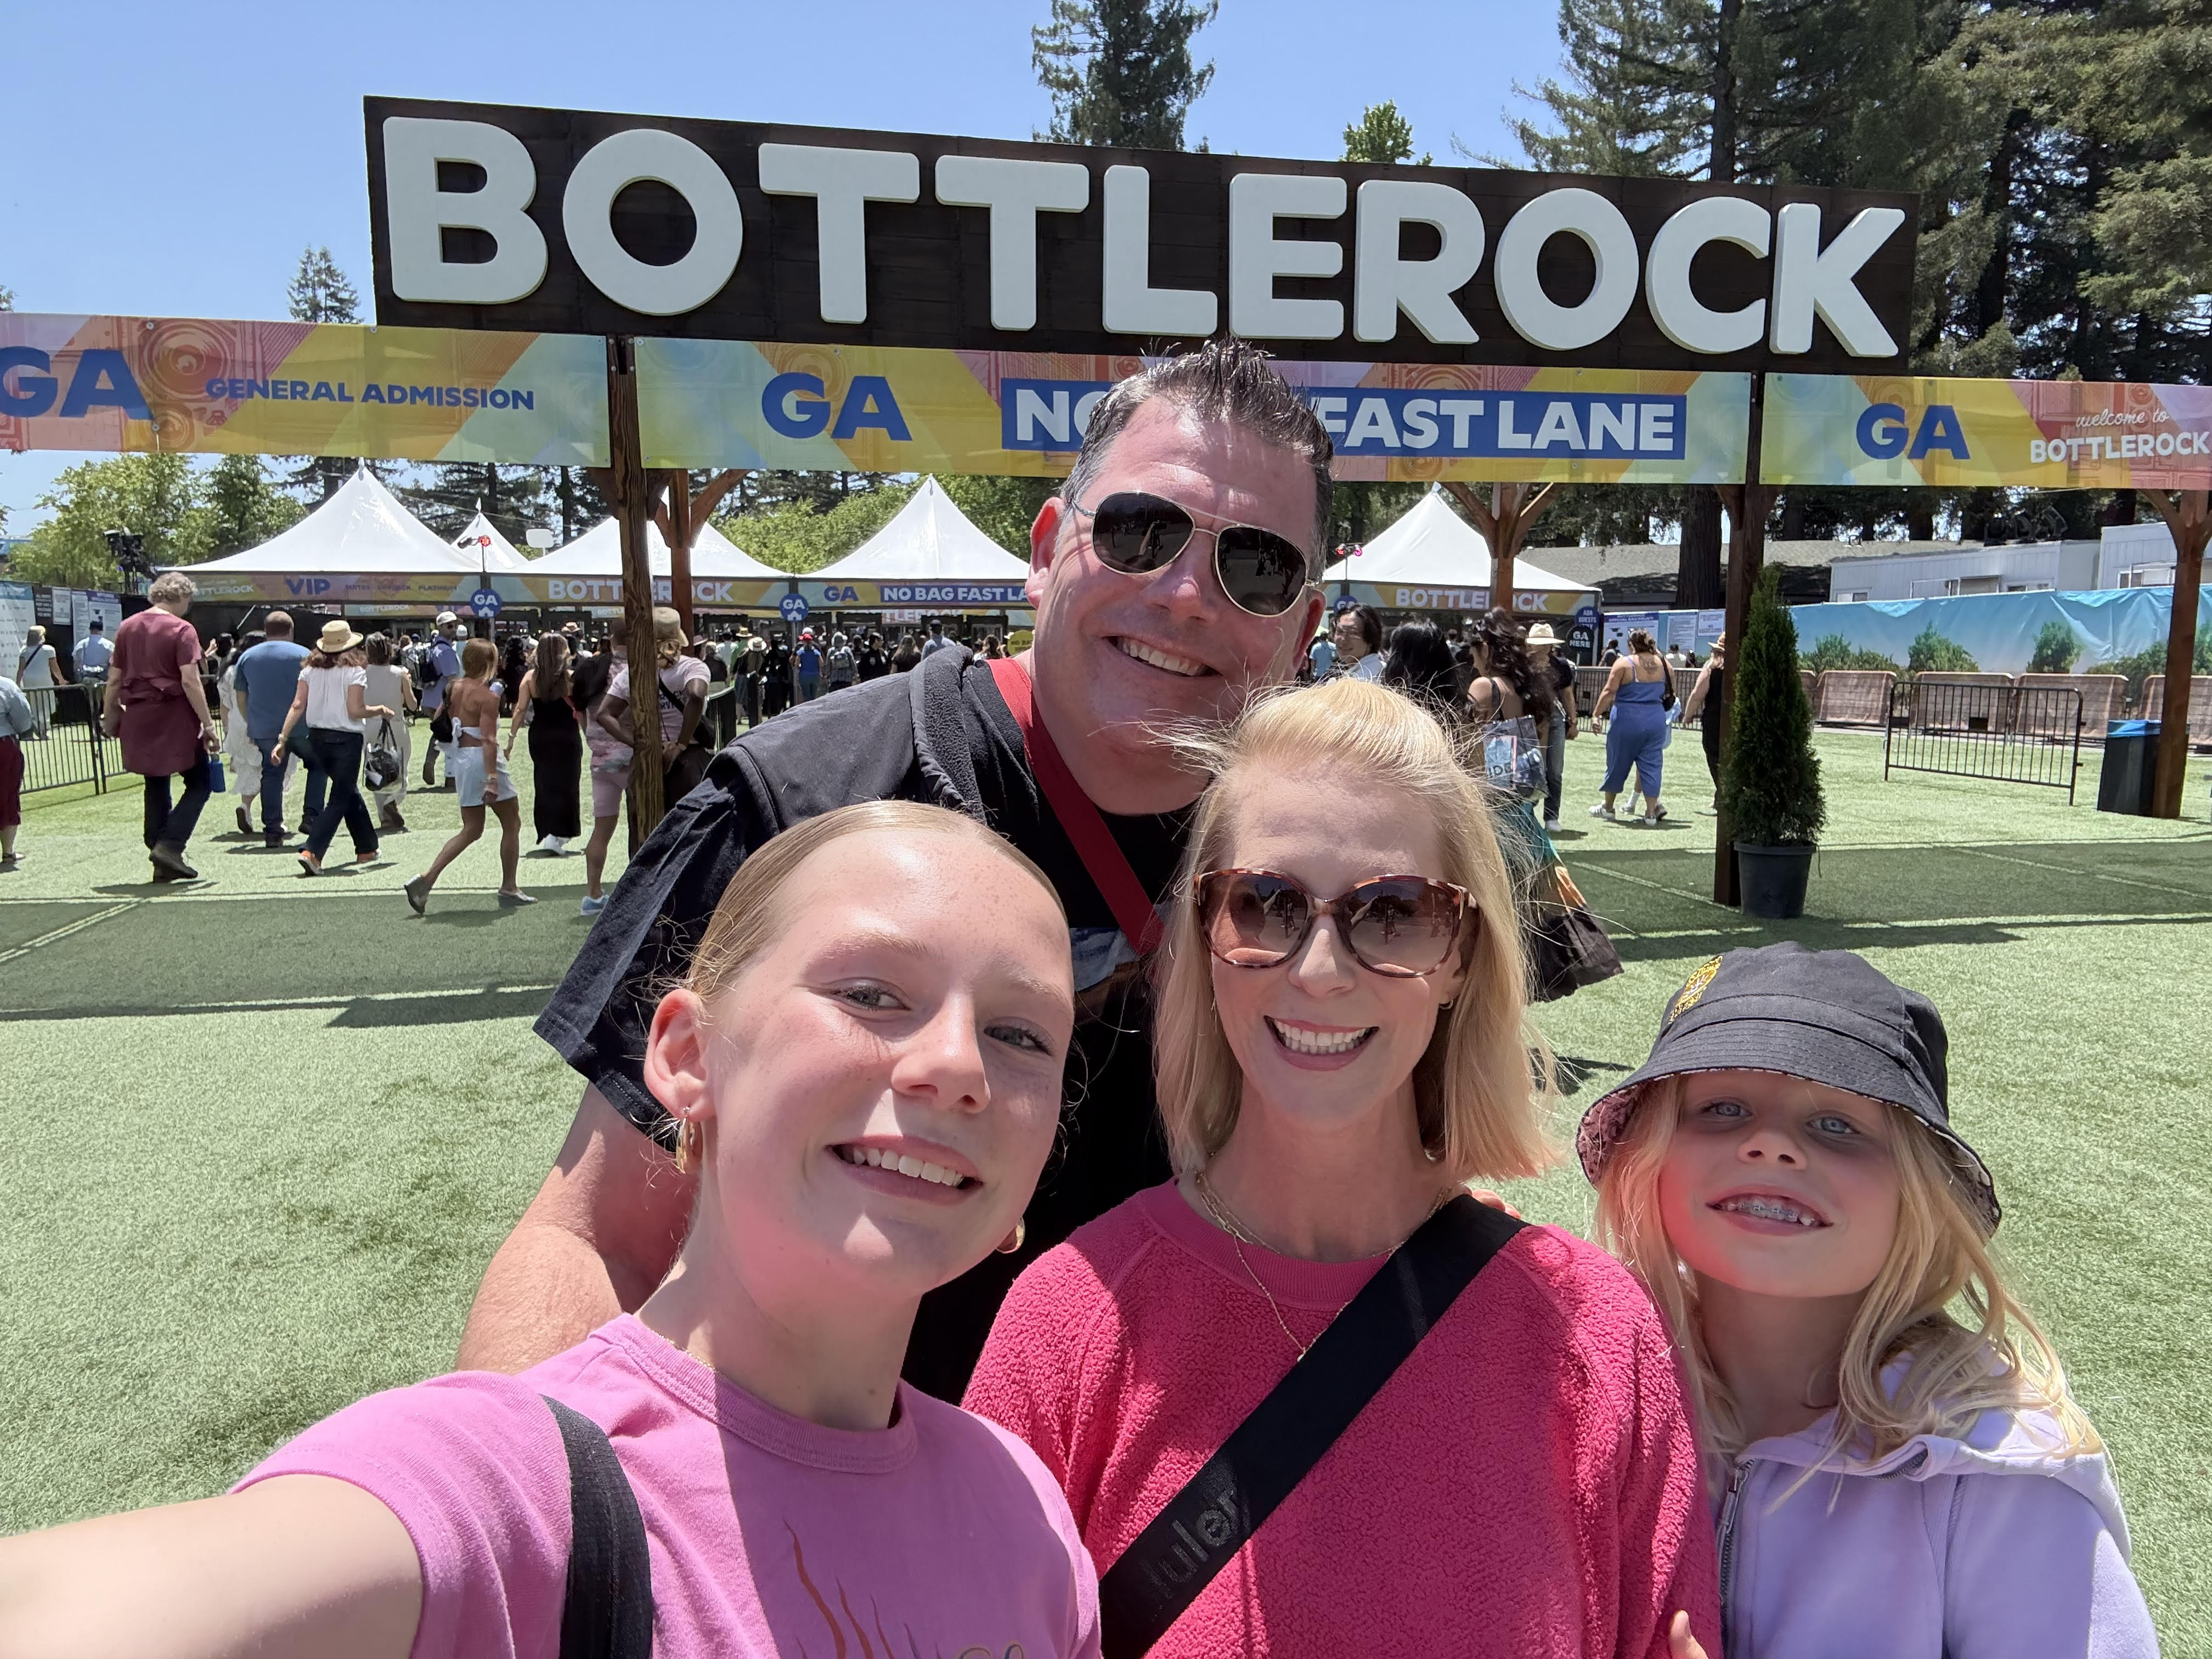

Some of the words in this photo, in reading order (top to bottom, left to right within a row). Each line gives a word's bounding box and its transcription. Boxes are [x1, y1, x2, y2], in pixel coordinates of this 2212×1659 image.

[383, 116, 1906, 359] BOTTLEROCK
[0, 346, 154, 420] GA
[206, 377, 354, 402] GENERAL
[361, 382, 534, 410] ADMISSION
[761, 372, 913, 441] GA
[1311, 397, 1485, 449] FAST
[1498, 400, 1674, 452] LANE
[2076, 408, 2145, 428] welcome
[2152, 408, 2170, 424] to
[1856, 403, 1971, 460] GA
[2030, 431, 2210, 463] BOTTLEROCK
[193, 585, 254, 596] OTTLEROCK
[285, 578, 331, 595] VIP
[549, 579, 733, 602] BOTTRCK
[824, 586, 859, 602] GA
[884, 588, 912, 601] NO
[915, 588, 955, 601] BAG
[958, 588, 1005, 601] FAST
[1007, 588, 1028, 601] LA
[474, 594, 498, 606] GA
[783, 599, 805, 610] GA
[1396, 589, 1548, 612] BOTTLECK
[597, 607, 624, 616] BOTTL
[1570, 640, 1590, 648] HERE
[1573, 631, 1589, 640] GA
